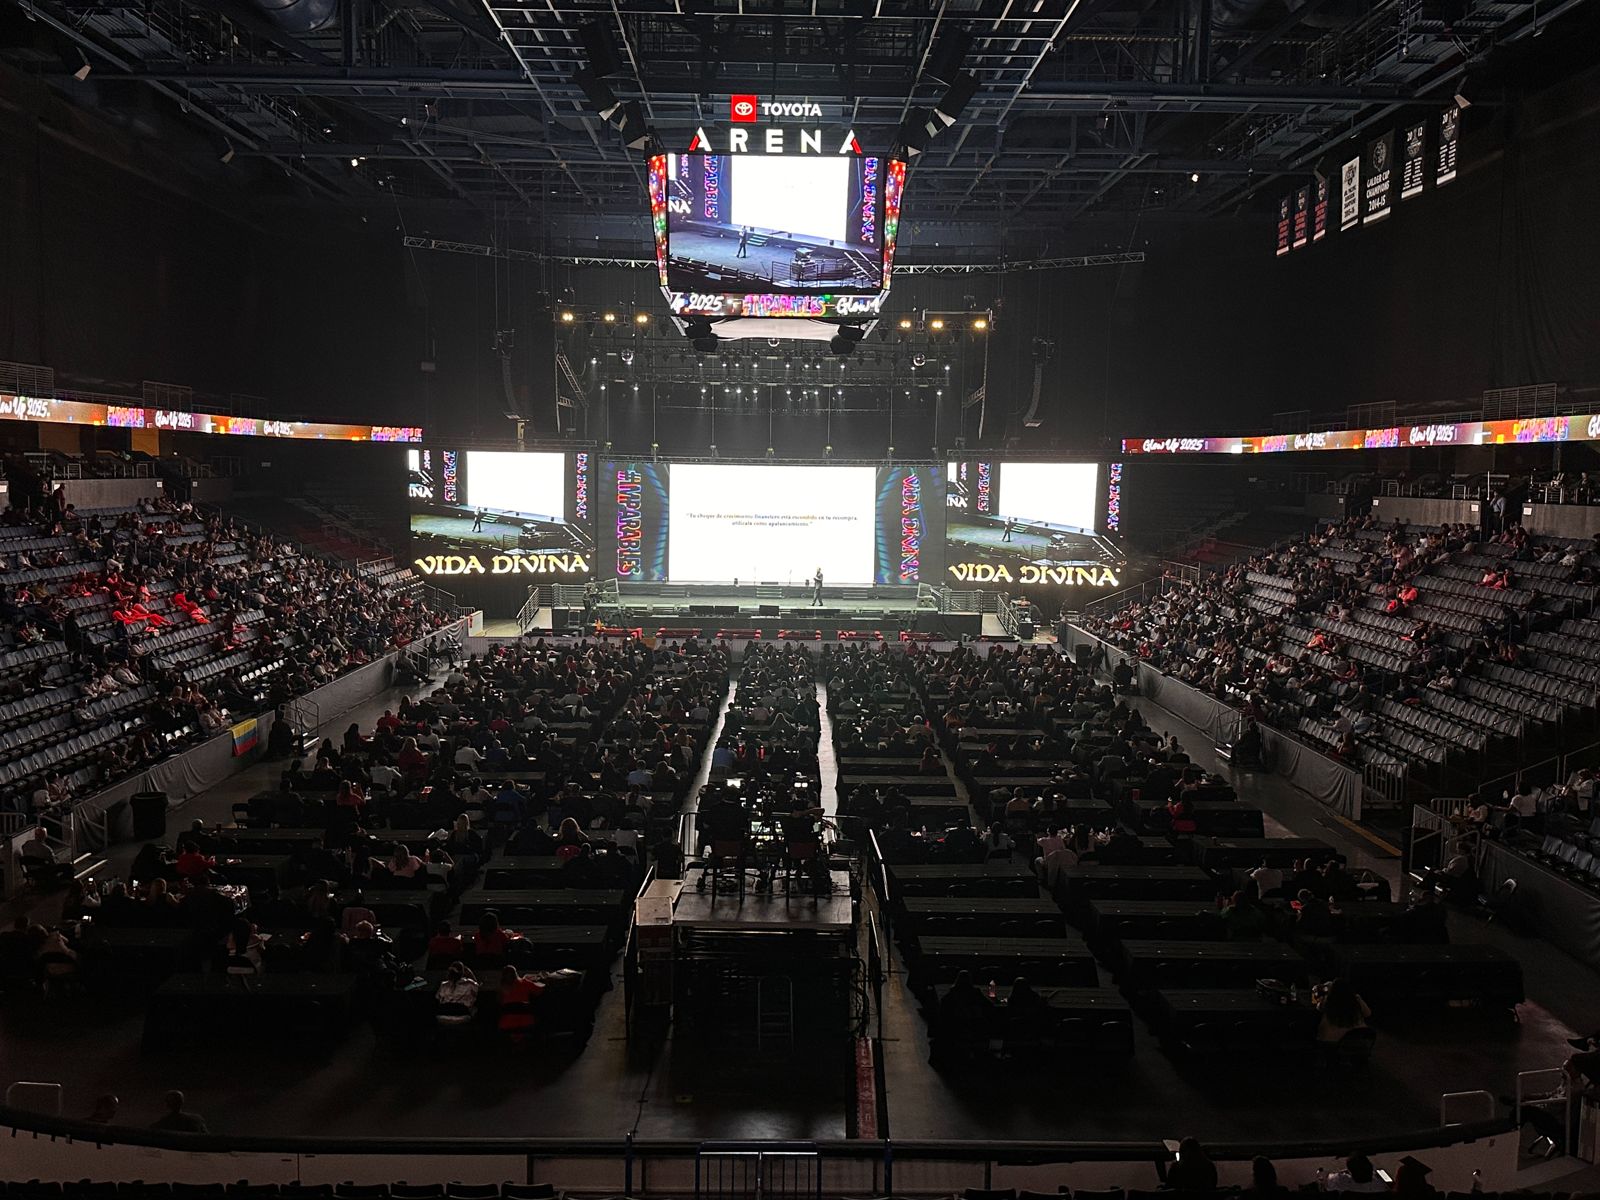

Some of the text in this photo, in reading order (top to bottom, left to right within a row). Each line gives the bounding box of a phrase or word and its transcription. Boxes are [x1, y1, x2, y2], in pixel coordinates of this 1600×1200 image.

[762, 102, 823, 117] TOYOTA
[689, 127, 862, 154] ARENA
[689, 293, 724, 311] 2025
[1143, 438, 1204, 453] Glow Up 2025
[901, 473, 921, 580] VIDA DIVINA
[414, 554, 591, 575] VIDA DIVINA
[948, 562, 1120, 588] VIDA DIVINA
